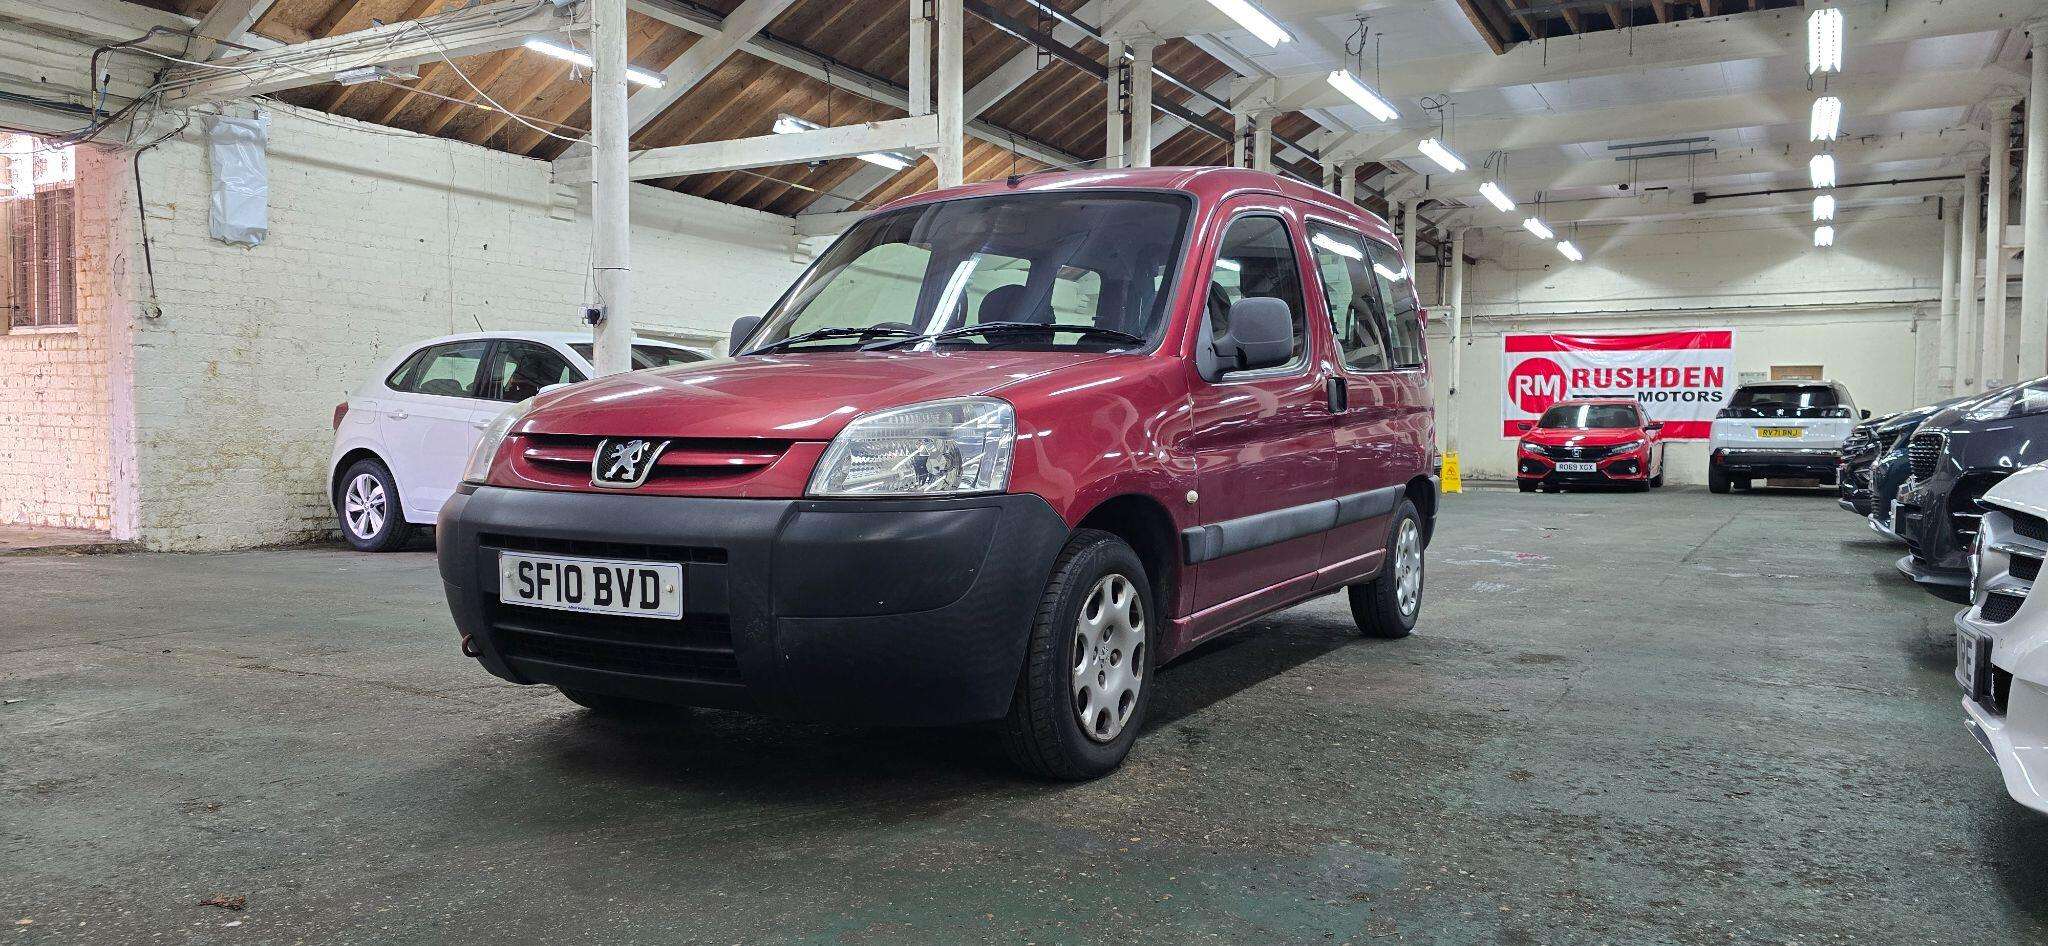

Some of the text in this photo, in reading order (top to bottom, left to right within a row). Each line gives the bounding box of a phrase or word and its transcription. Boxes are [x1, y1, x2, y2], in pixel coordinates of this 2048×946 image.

[1515, 374, 1561, 407] RM
[1572, 367, 1724, 389] RUSHDEN
[1637, 391, 1723, 402] MOTORS
[518, 560, 660, 610] SF10 BVD
